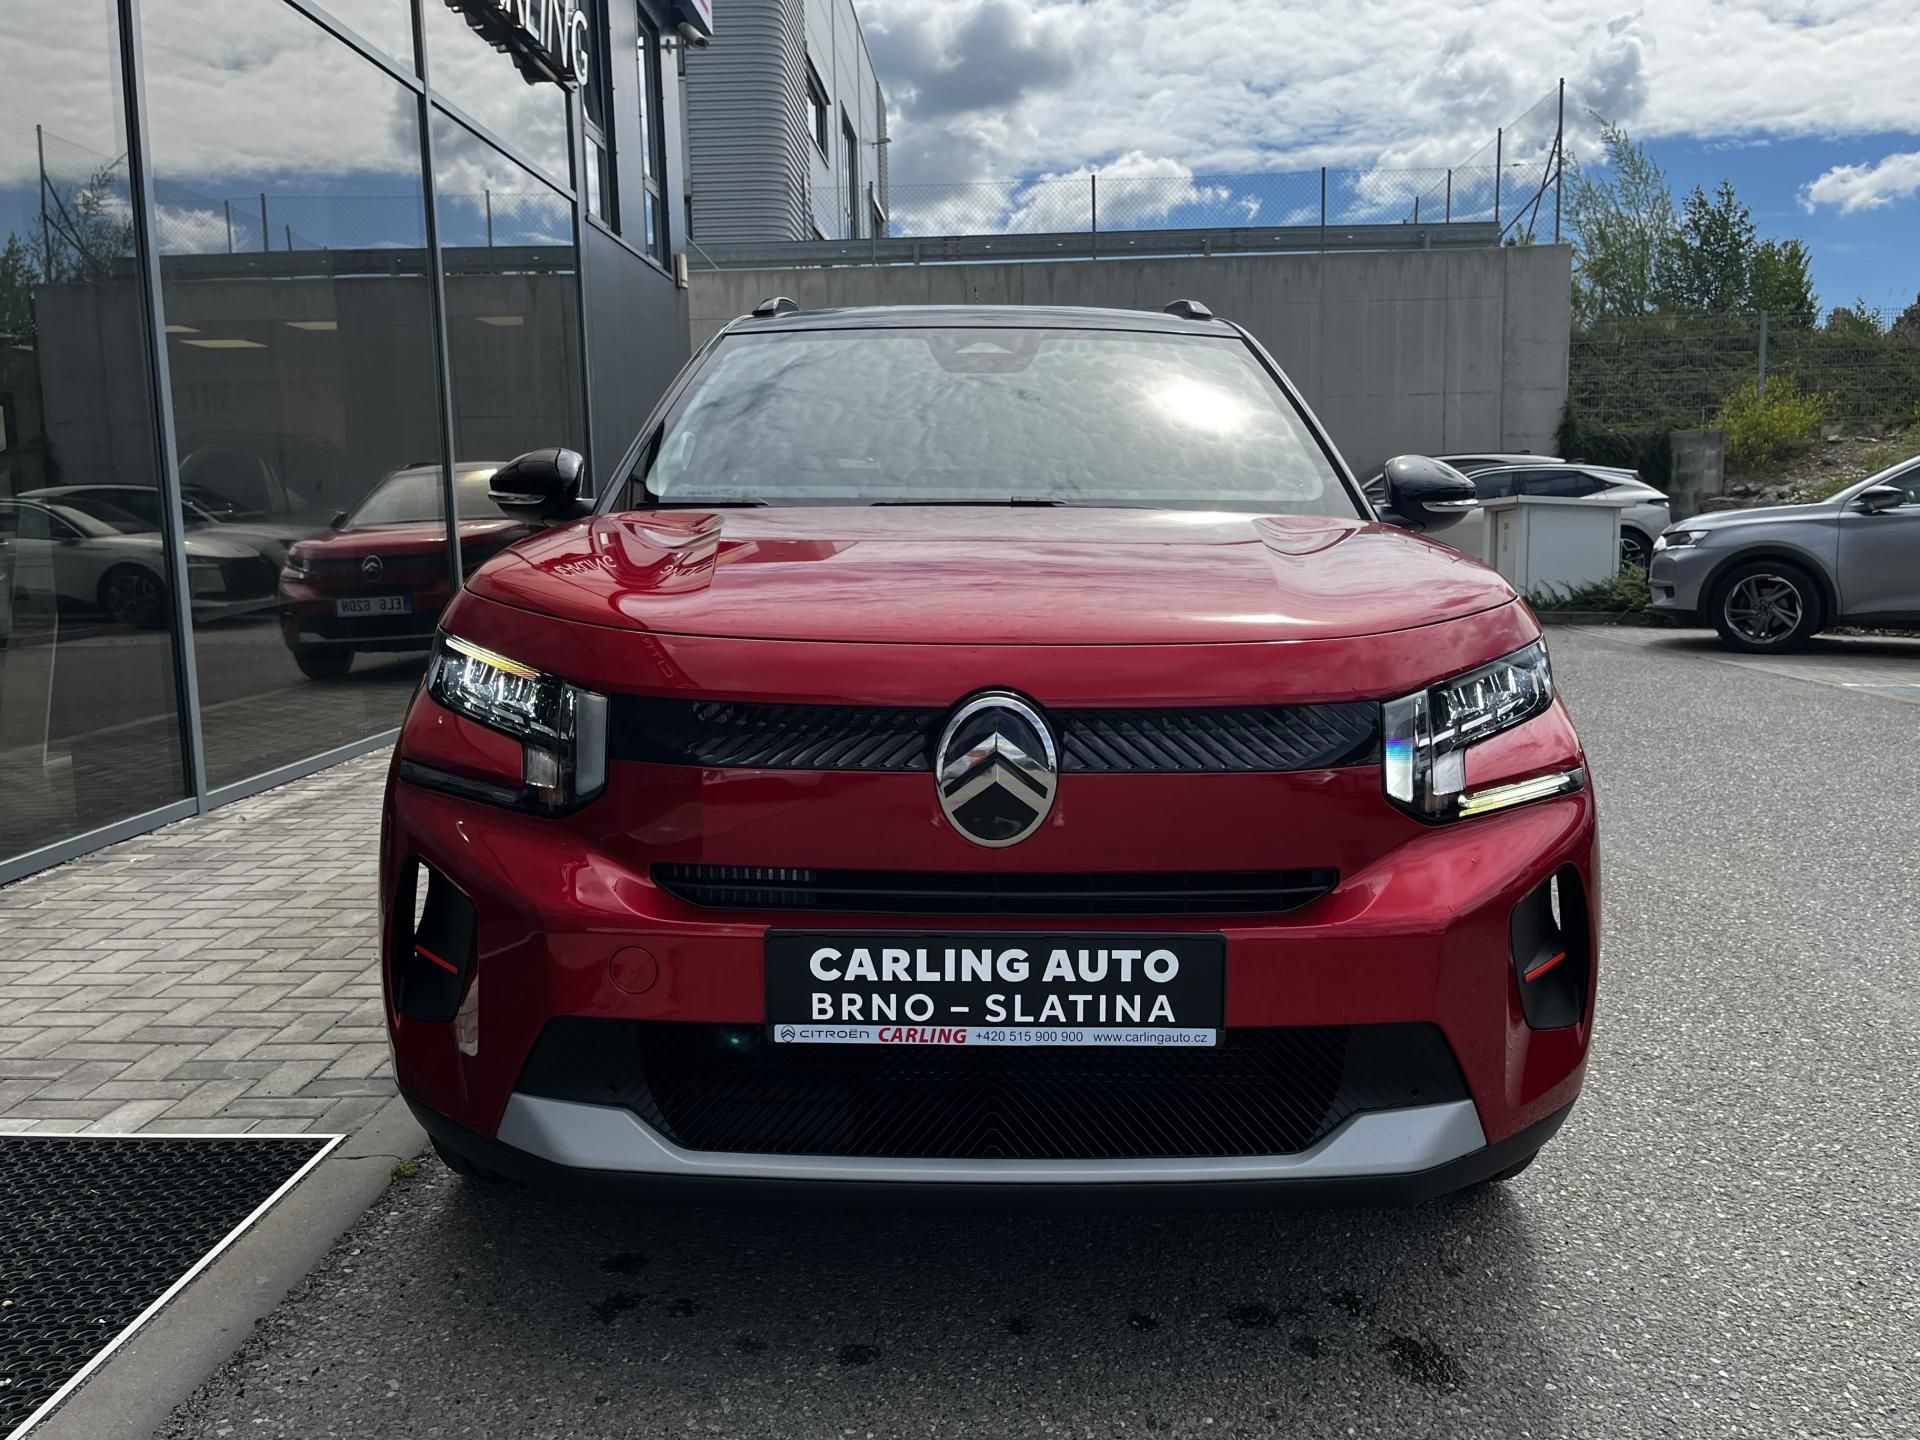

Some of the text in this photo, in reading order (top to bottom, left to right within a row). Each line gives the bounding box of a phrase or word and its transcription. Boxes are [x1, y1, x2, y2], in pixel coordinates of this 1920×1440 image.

[809, 947, 1180, 983] CARLING AUTO
[811, 992, 935, 1022] BRNO
[985, 994, 1176, 1023] SLATINA
[878, 1027, 968, 1044] CARLING
[975, 1031, 1005, 1042] +420
[1009, 1031, 1032, 1042] 515
[1035, 1031, 1058, 1042] 900
[1061, 1031, 1084, 1042] 900
[1093, 1031, 1208, 1045] www.carlingauto.cz
